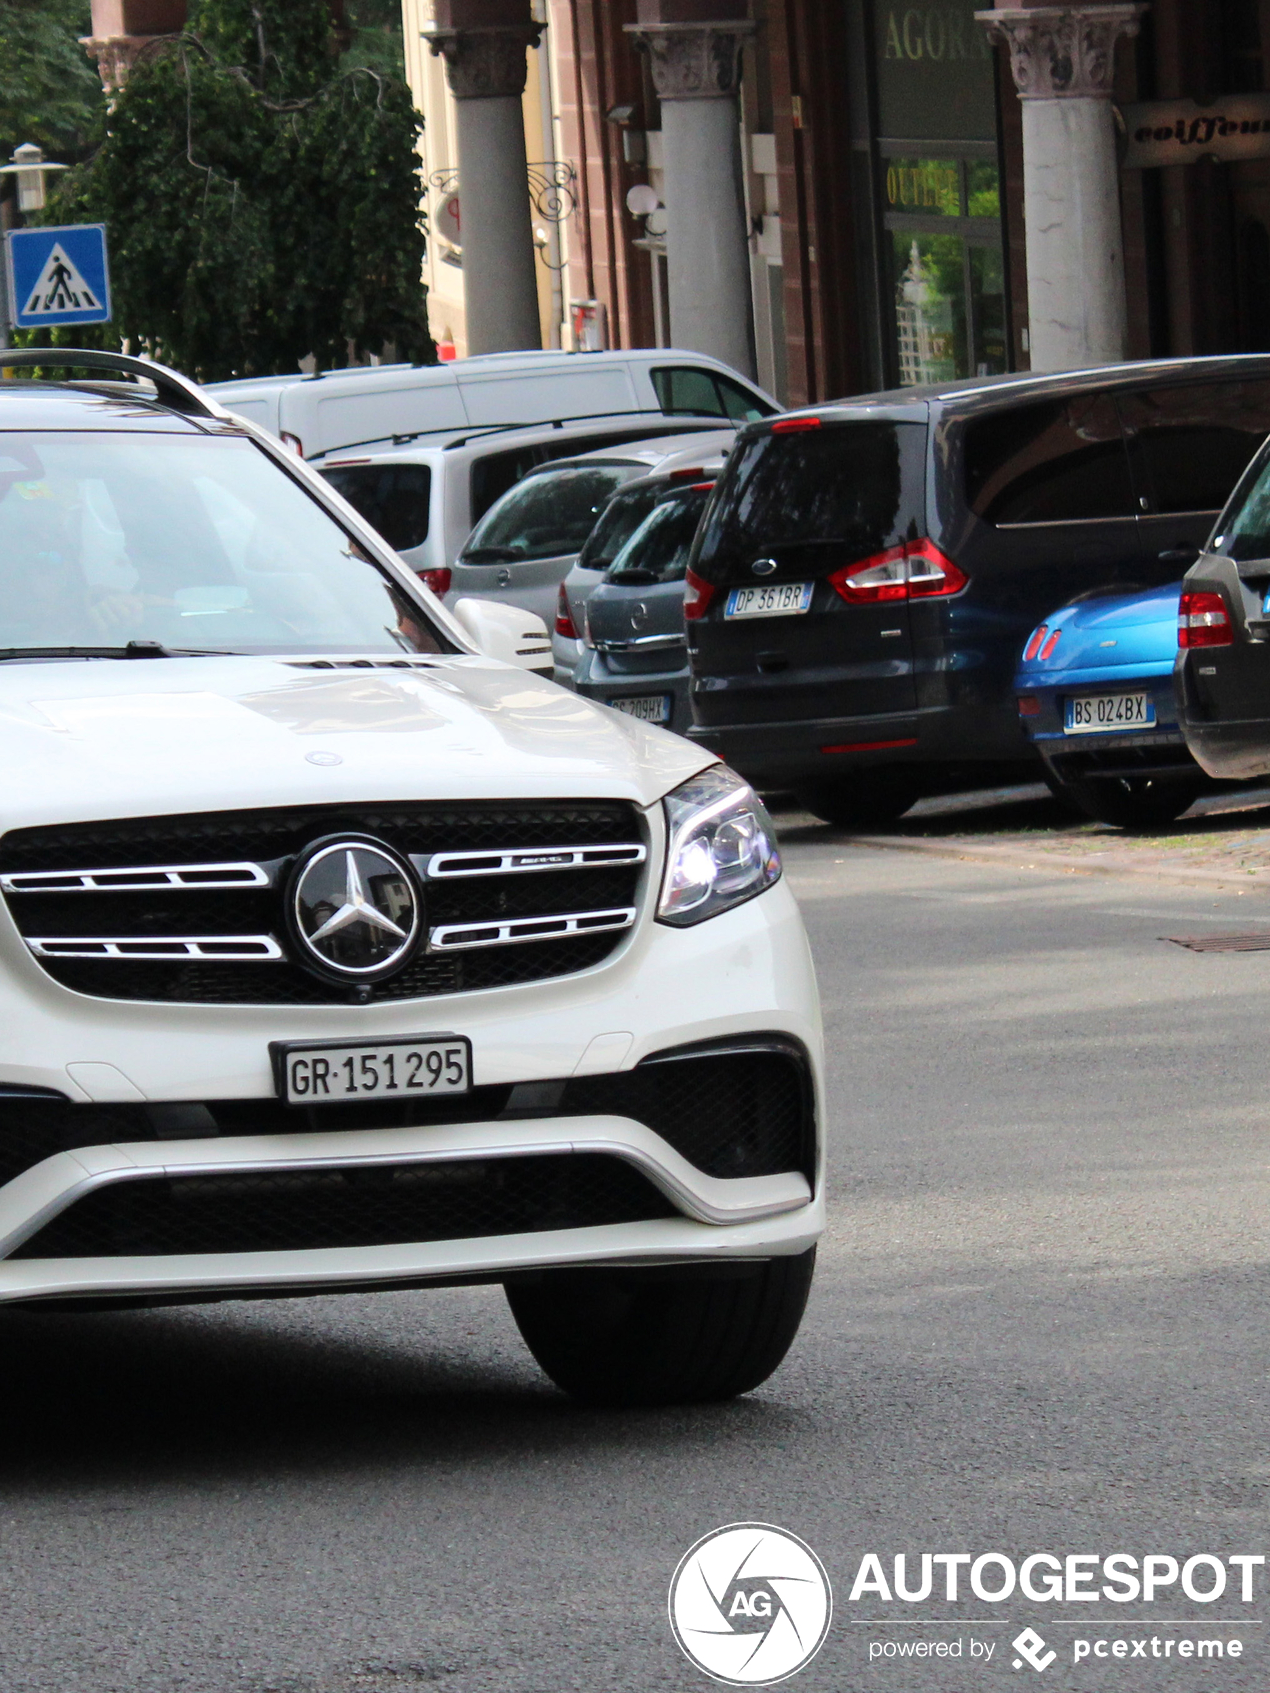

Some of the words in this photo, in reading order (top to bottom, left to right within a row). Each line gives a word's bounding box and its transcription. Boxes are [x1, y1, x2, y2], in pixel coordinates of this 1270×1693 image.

[736, 589, 755, 612] DP
[758, 585, 802, 610] 361BR
[1074, 700, 1092, 724] BS
[1097, 696, 1144, 722] 024BX
